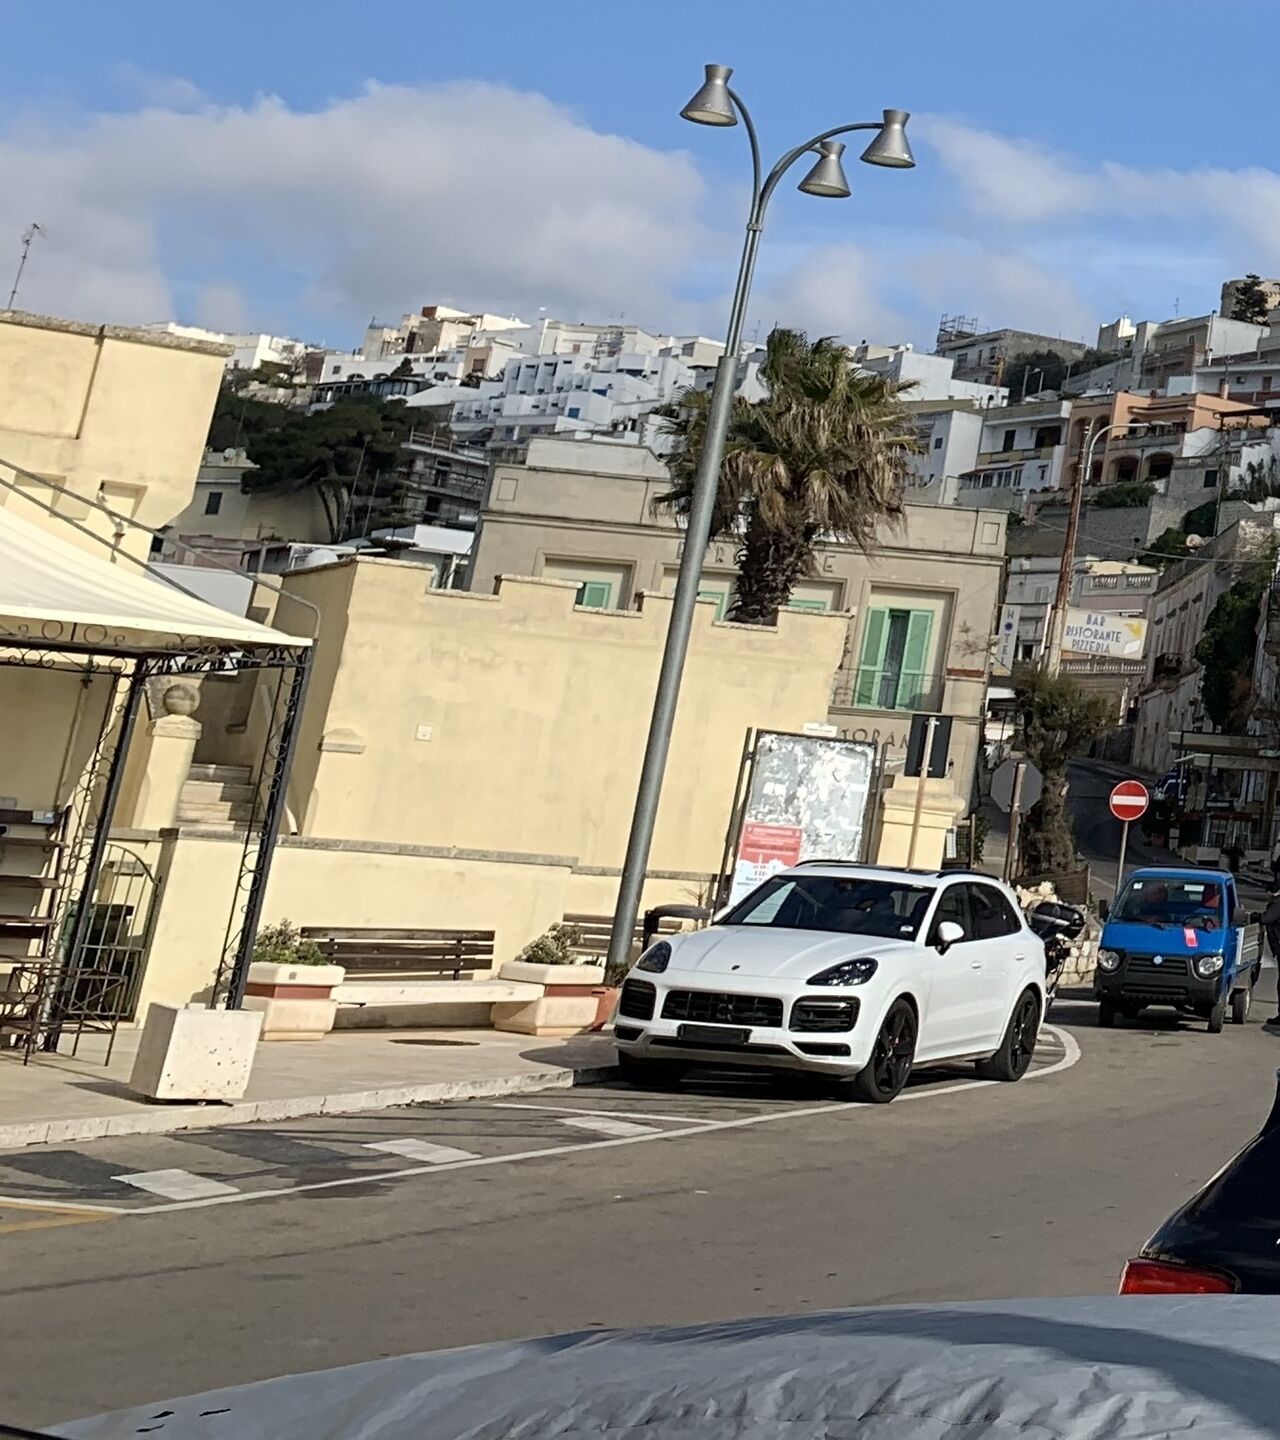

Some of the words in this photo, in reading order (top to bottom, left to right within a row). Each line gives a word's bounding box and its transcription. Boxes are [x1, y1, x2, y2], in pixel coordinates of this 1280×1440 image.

[1085, 613, 1106, 627] BAR
[1065, 625, 1122, 643] RISTORANTE
[1071, 640, 1111, 656] PIZZERIA
